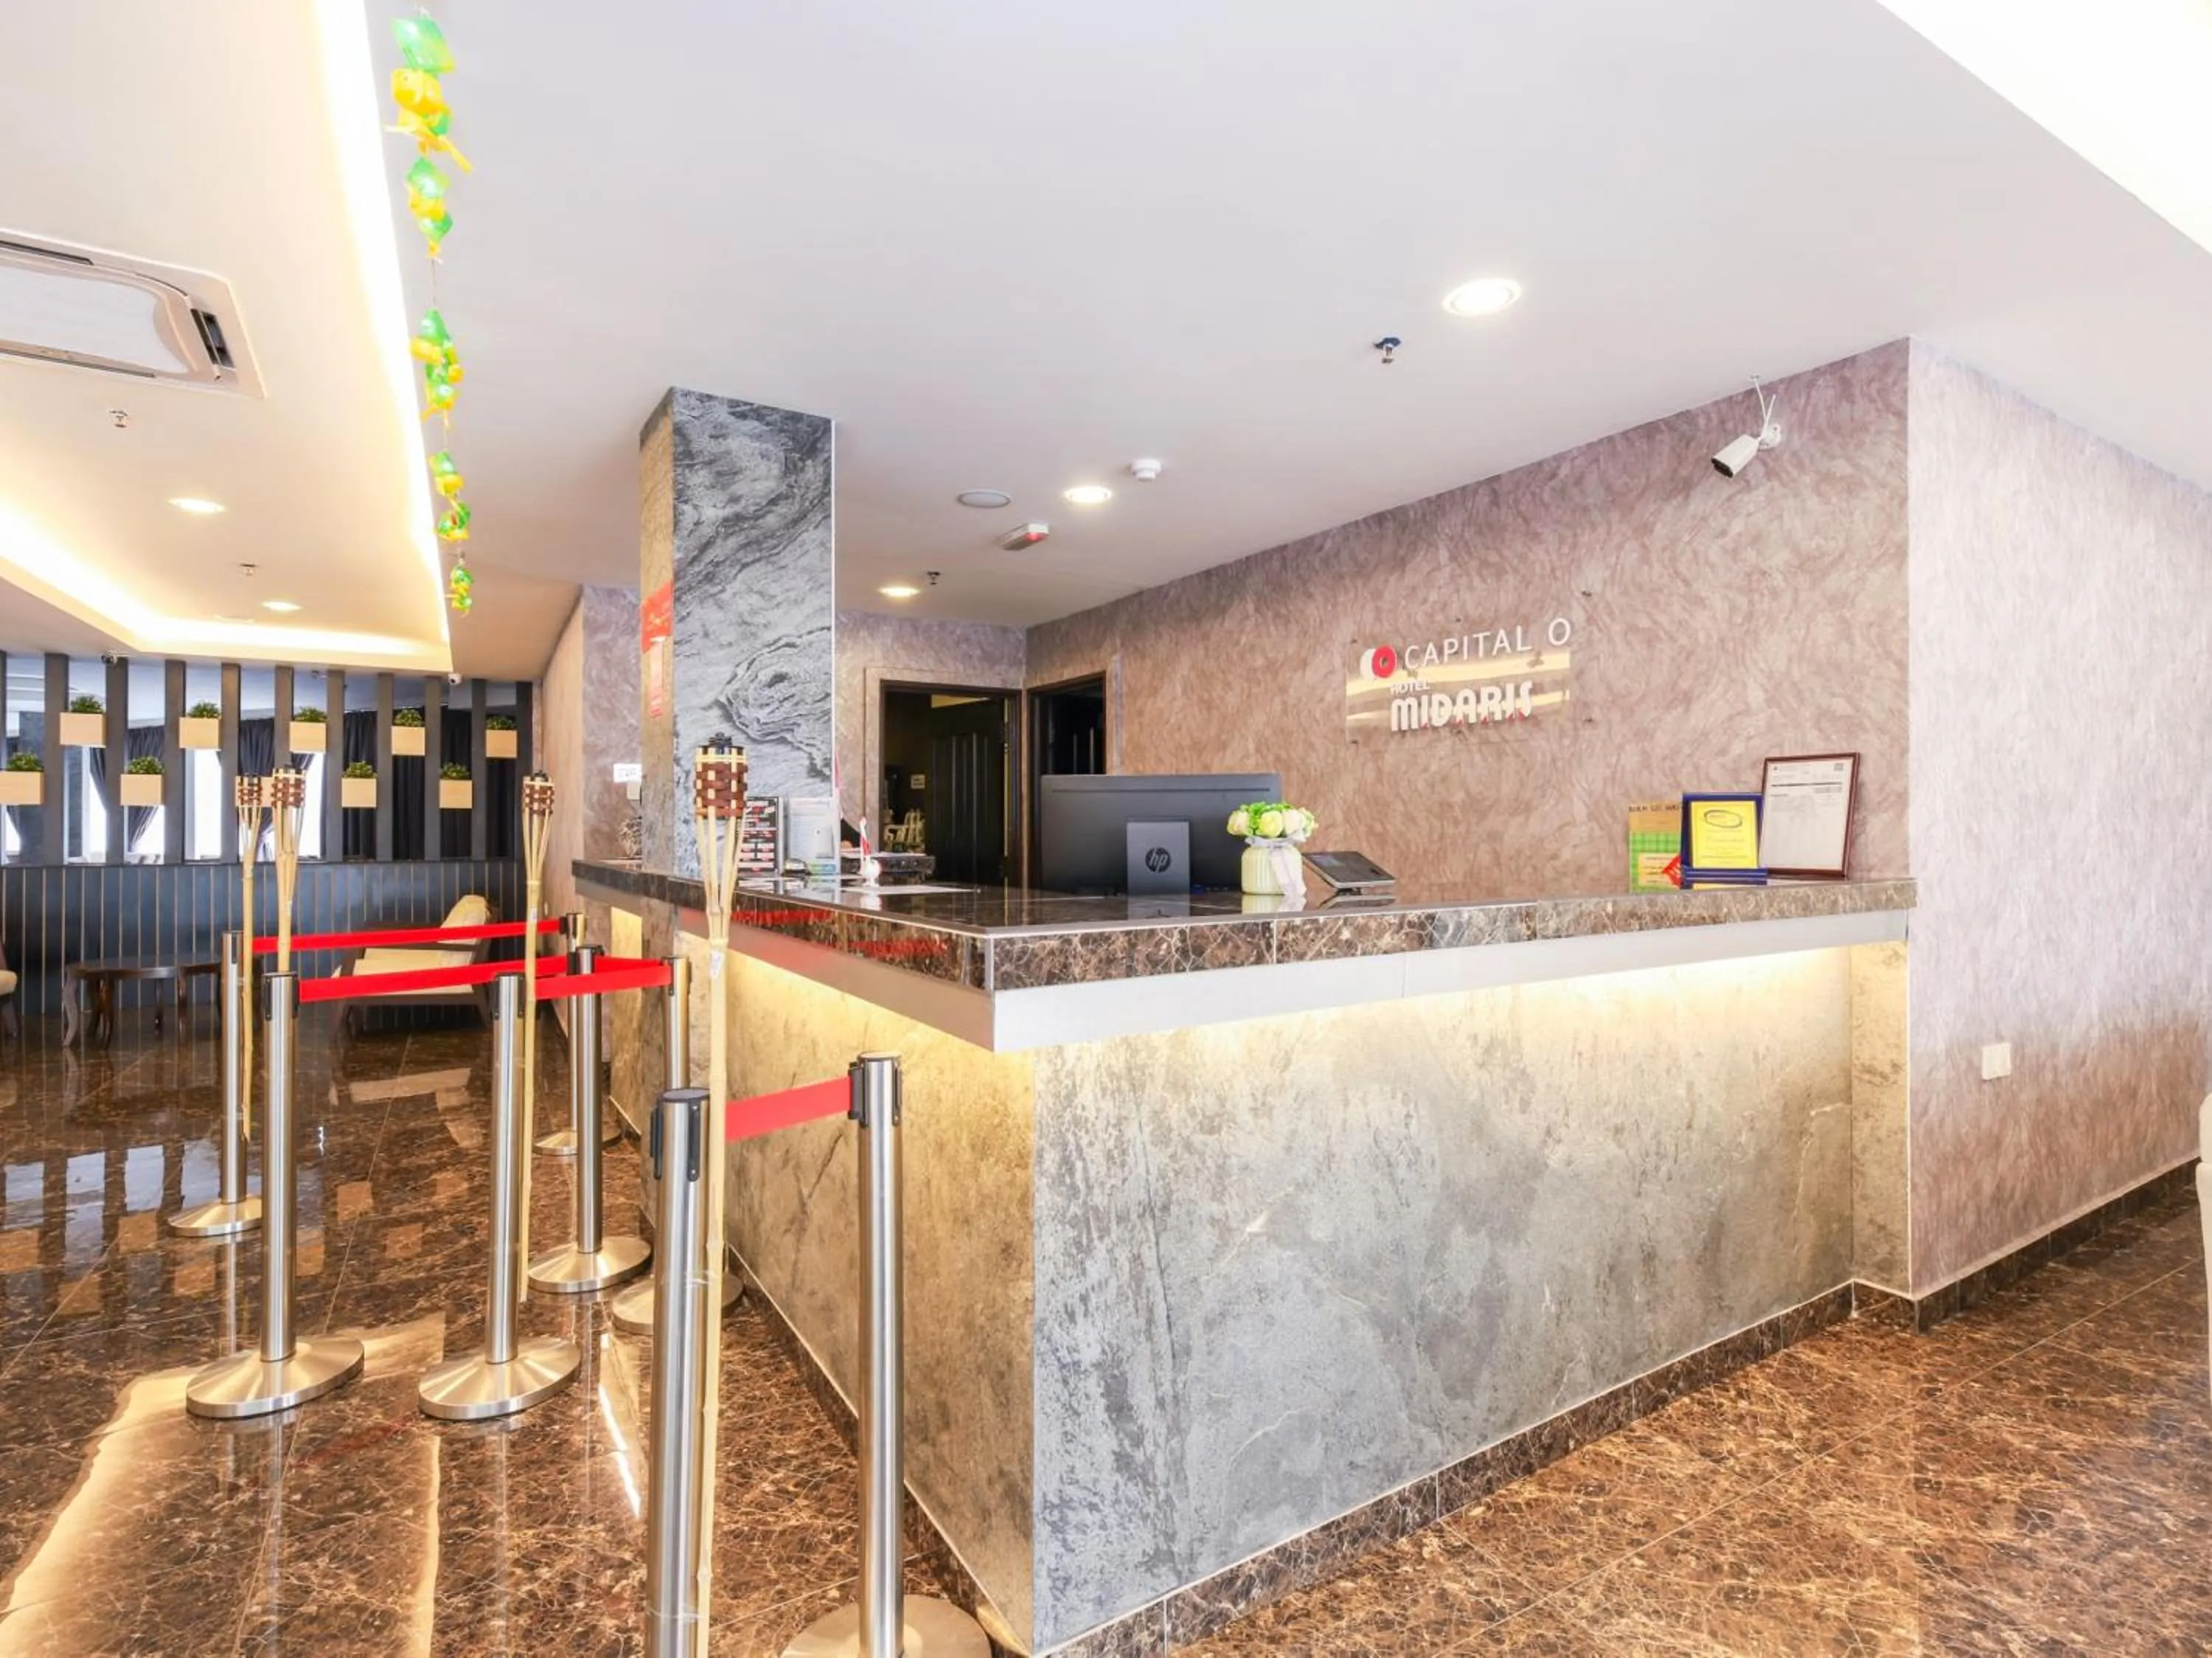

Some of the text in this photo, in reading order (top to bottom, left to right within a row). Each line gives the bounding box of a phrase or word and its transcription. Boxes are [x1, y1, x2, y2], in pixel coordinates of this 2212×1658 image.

[1405, 617, 1571, 670] CAPITAL O
[1390, 678, 1430, 695] HOTEL
[1391, 680, 1534, 732] MIDARIS
[1148, 847, 1170, 873] hp
